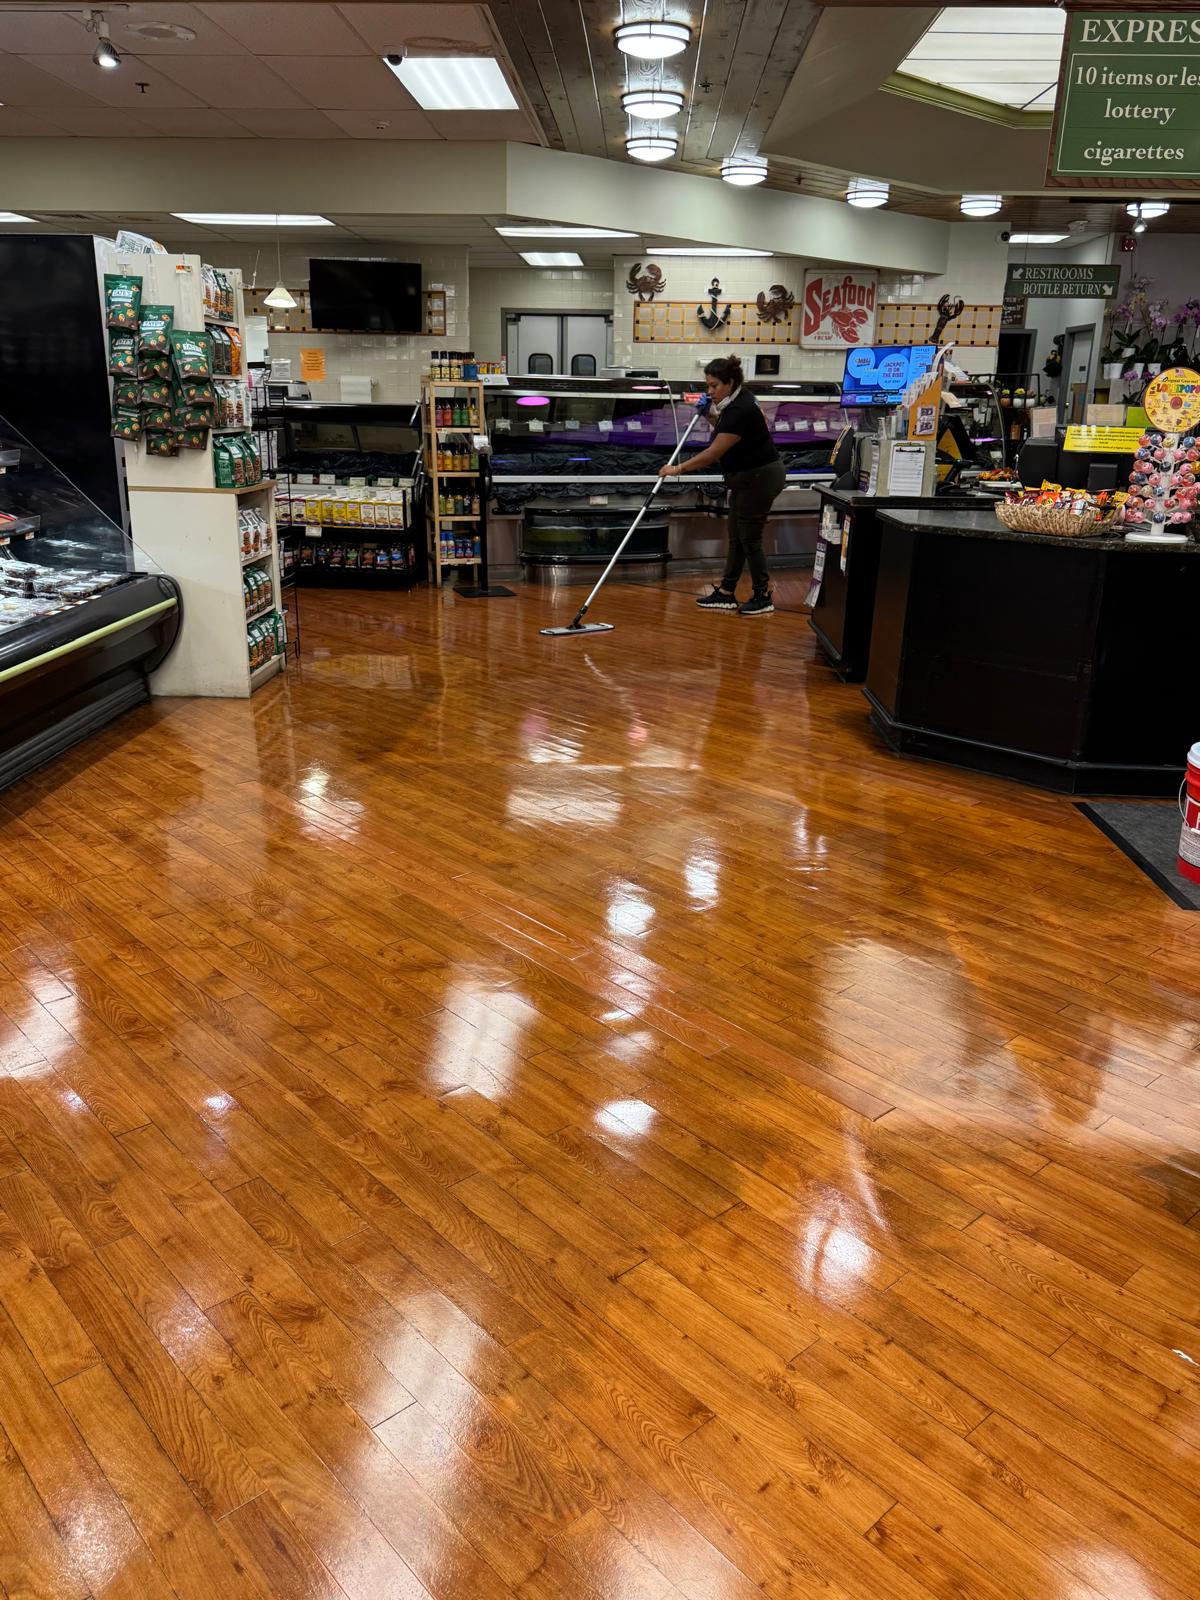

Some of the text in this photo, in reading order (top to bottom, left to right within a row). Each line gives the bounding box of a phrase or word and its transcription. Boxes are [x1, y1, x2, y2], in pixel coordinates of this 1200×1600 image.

[1075, 66, 1097, 85] 10
[1101, 66, 1152, 86] items
[1156, 73, 1178, 86] or
[1103, 98, 1176, 125] lottery
[1083, 140, 1185, 166] cigarettes
[1024, 267, 1094, 280] RESTROOMS
[1023, 283, 1101, 295] BOTTLE RETURN
